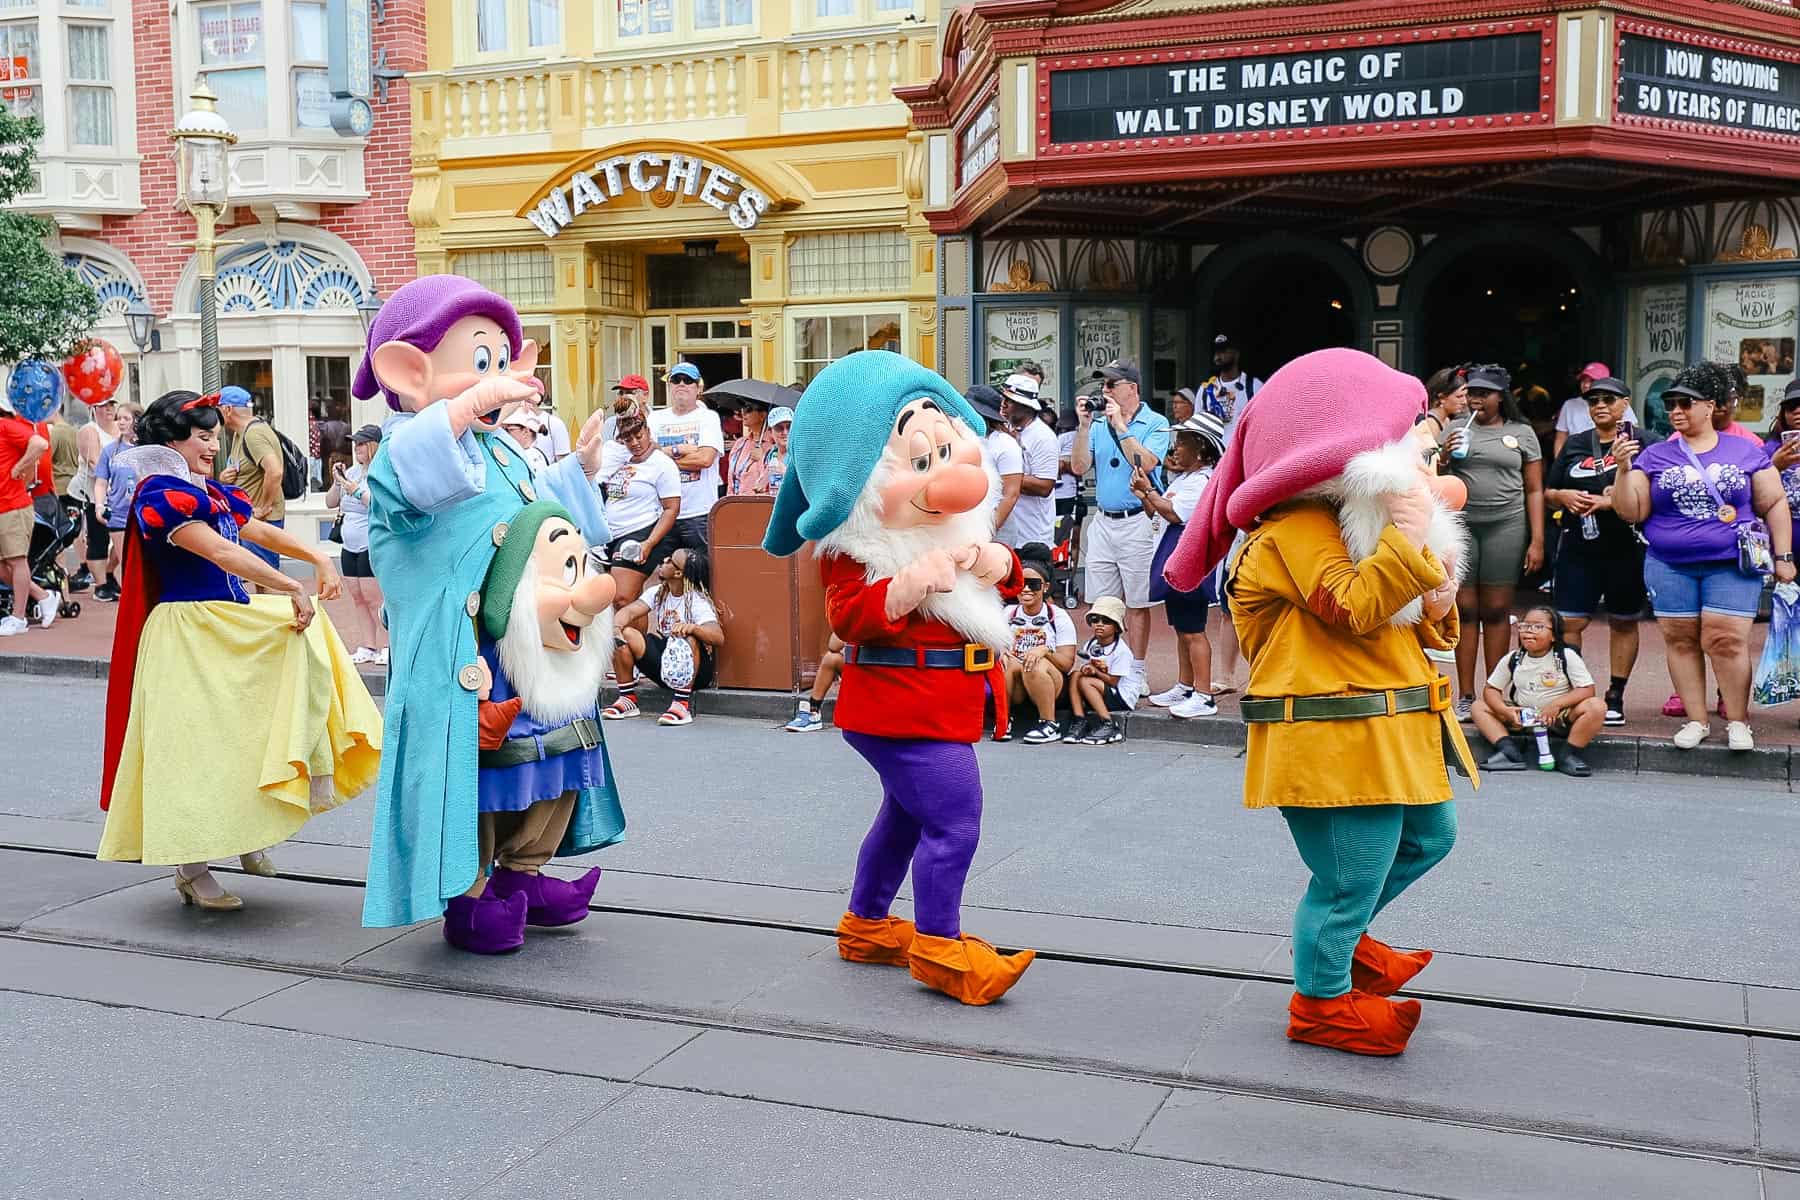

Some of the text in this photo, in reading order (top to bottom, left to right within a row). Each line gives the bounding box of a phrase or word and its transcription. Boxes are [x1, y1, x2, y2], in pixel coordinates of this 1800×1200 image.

[1168, 52, 1402, 94] THE MAGIC OF
[1665, 48, 1780, 92] NOW SHOWING
[1115, 87, 1465, 135] WALT DISNEY WORLD
[1637, 85, 1800, 132] 50 YEARS OF MAGIC
[527, 152, 770, 238] WATCHES
[1739, 302, 1776, 318] WDW
[1009, 327, 1038, 342] WDW
[1077, 327, 1111, 349] MAGIC
[1649, 329, 1686, 354] WDW
[1082, 345, 1121, 368] WDW
